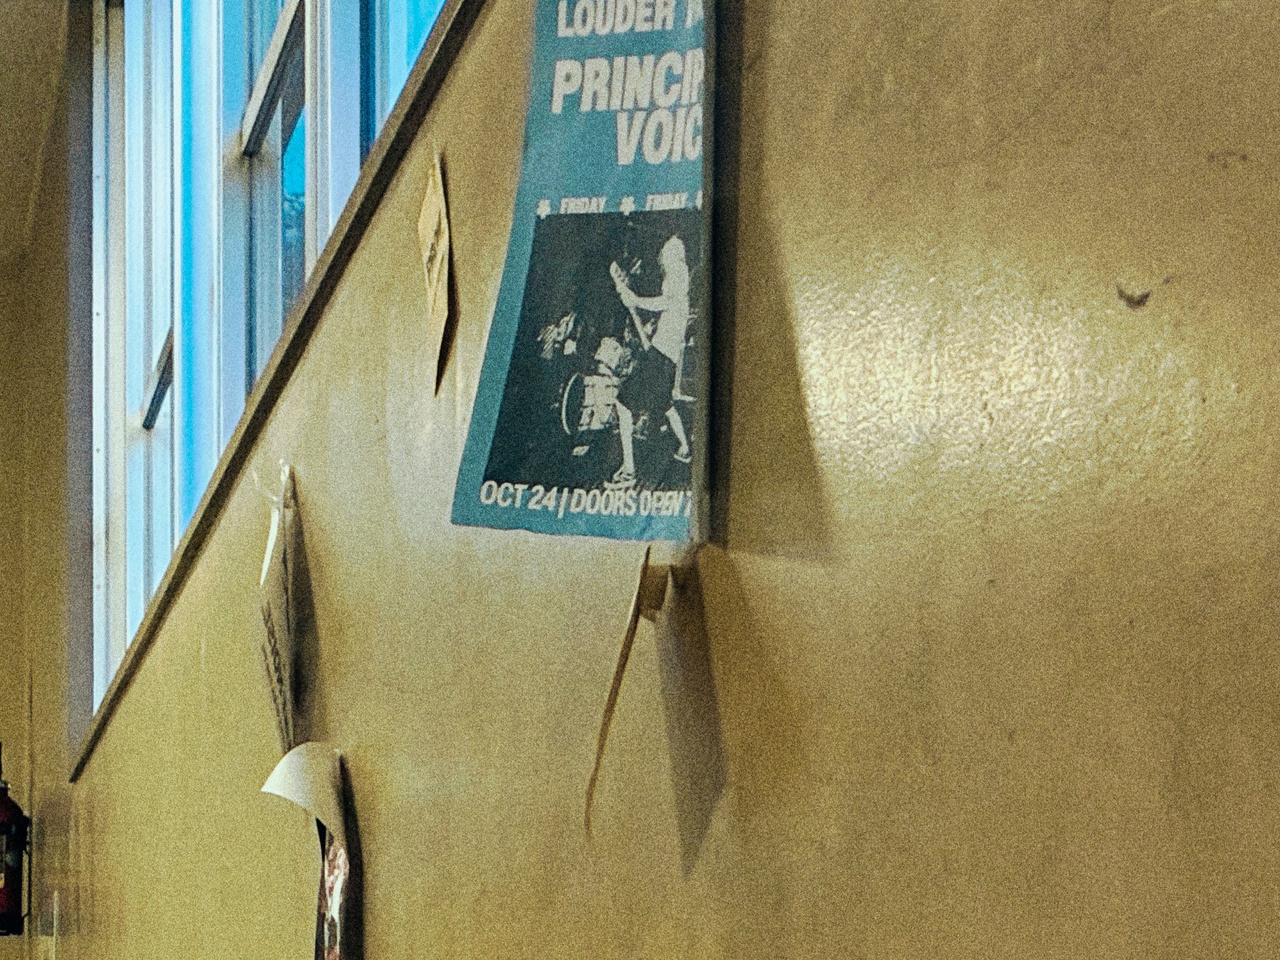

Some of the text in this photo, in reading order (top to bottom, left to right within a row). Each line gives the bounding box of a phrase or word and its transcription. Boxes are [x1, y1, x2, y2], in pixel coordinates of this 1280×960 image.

[557, 0, 675, 37] LOUDER
[479, 480, 530, 508] OCT
[527, 485, 559, 511] 24
[570, 488, 637, 516] DOORS
